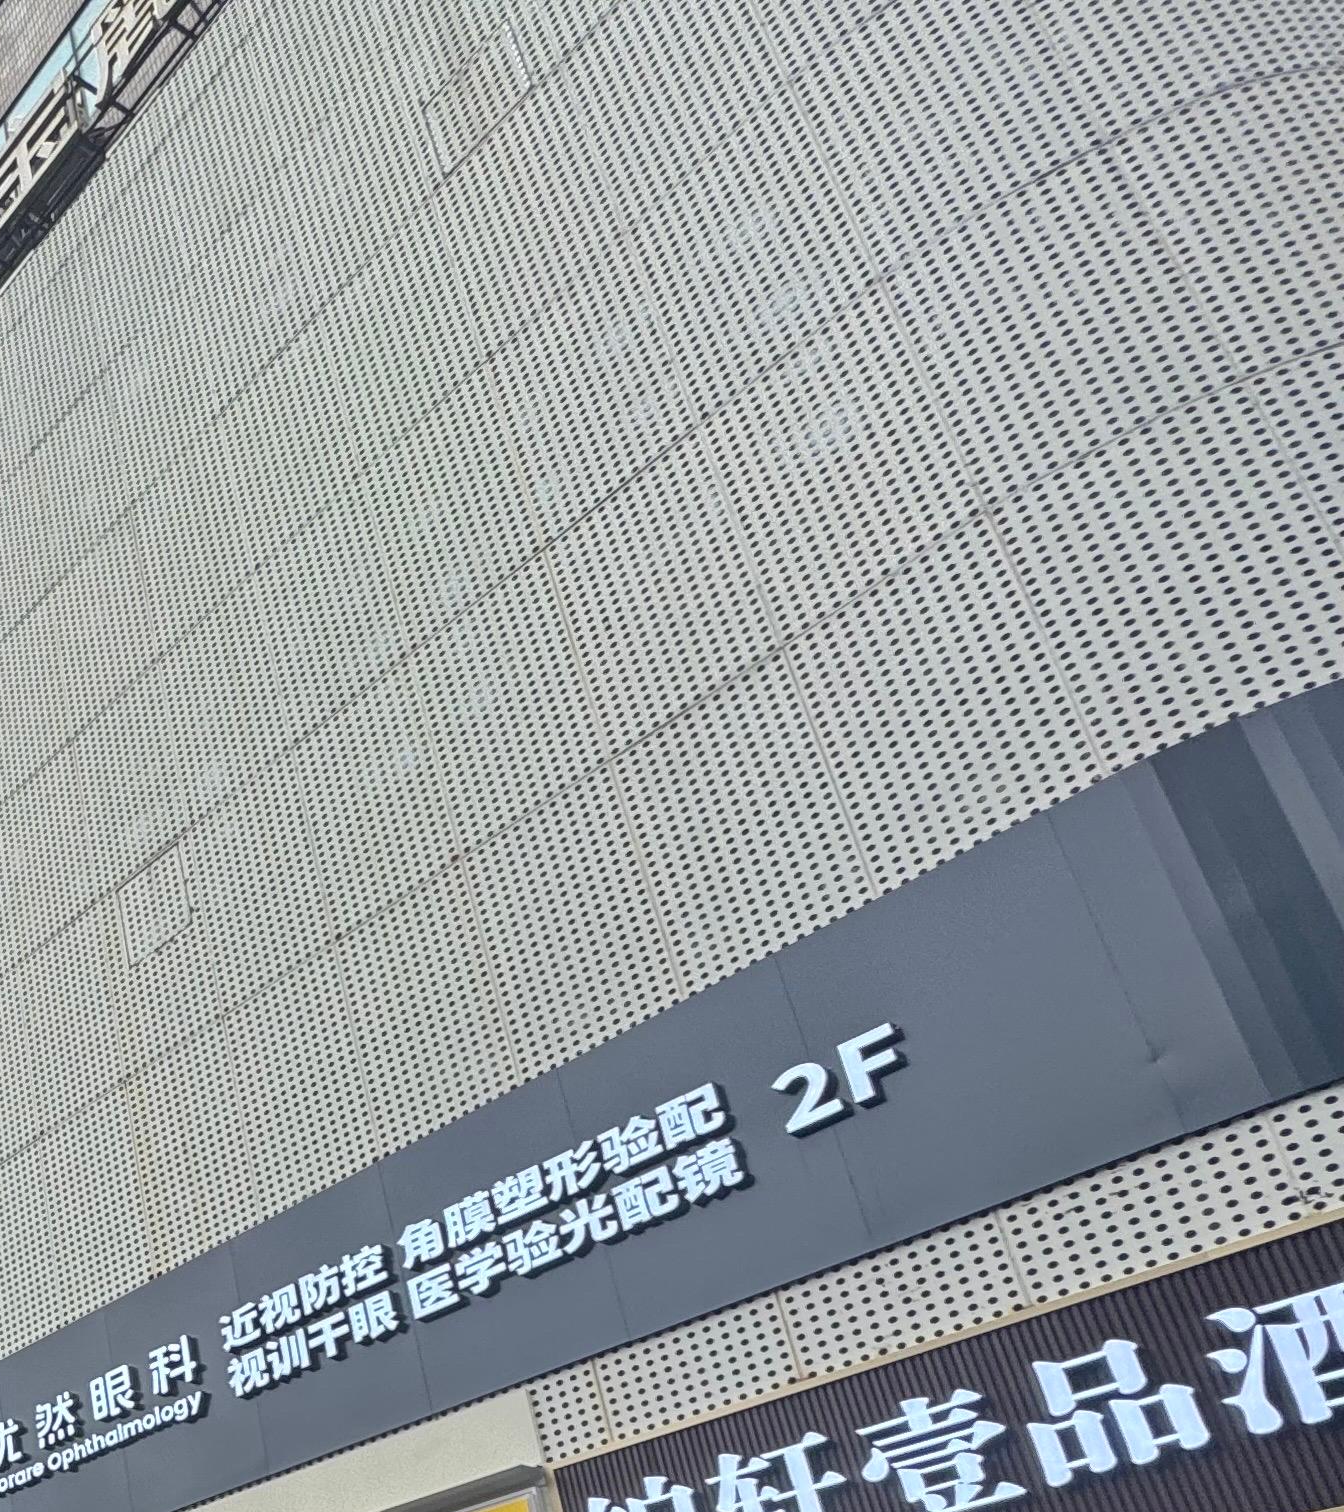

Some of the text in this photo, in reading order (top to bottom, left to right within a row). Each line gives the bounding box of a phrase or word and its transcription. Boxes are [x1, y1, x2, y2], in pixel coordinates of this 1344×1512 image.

[771, 1023, 900, 1136] 2F
[219, 1082, 726, 1353] 近视防控 角膜塑形验配
[227, 1139, 744, 1397] 视训干眼 医学验光配镜
[47, 1391, 202, 1472] Ophthalmology
